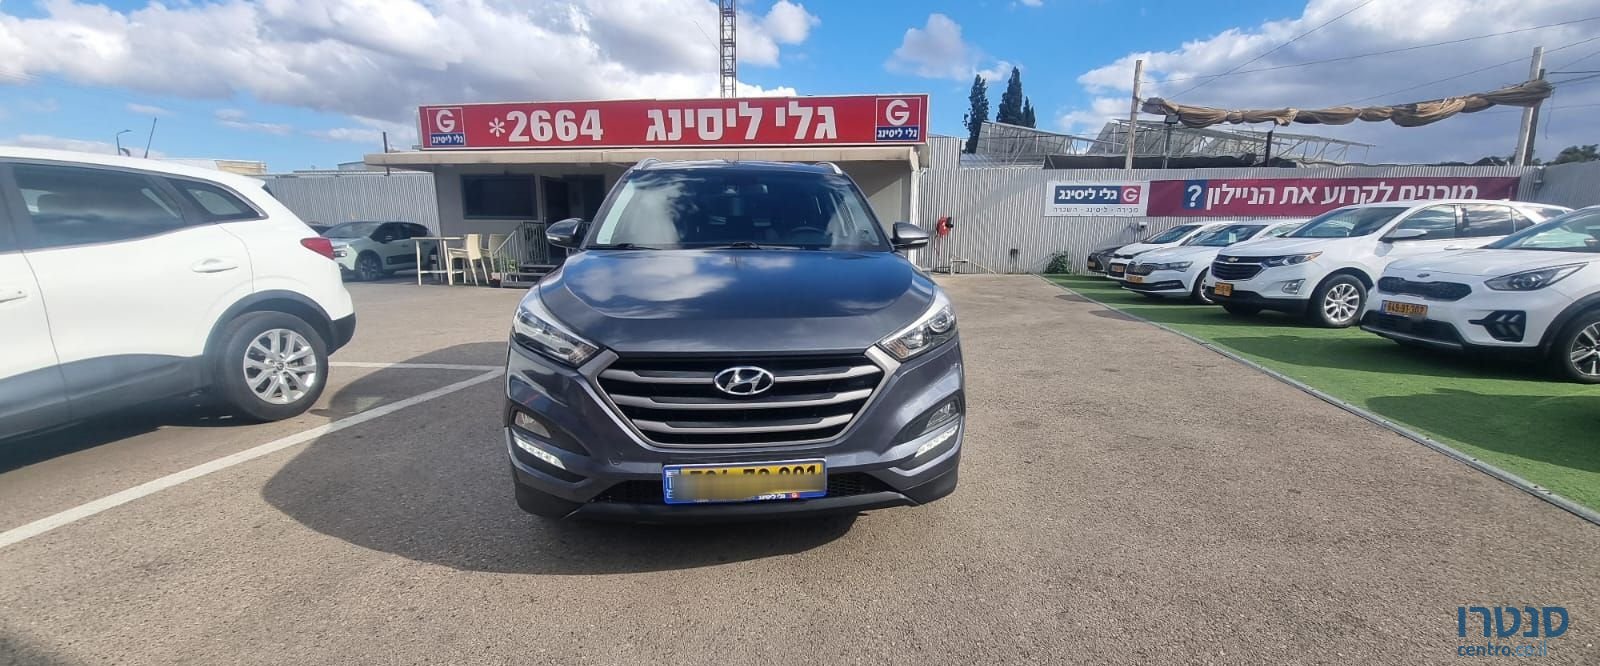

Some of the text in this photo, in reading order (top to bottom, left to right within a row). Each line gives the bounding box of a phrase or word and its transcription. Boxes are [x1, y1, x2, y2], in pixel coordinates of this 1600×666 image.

[435, 109, 456, 133] G
[646, 100, 838, 142] גלי ליסינג
[886, 99, 910, 126] G
[877, 127, 918, 138] גלי ליסינג
[1058, 187, 1118, 200] גלי ליסינג
[1122, 187, 1138, 202] G
[1279, 186, 1316, 206] את
[1320, 181, 1394, 205] לקרוע
[1398, 184, 1478, 201] מוכנים
